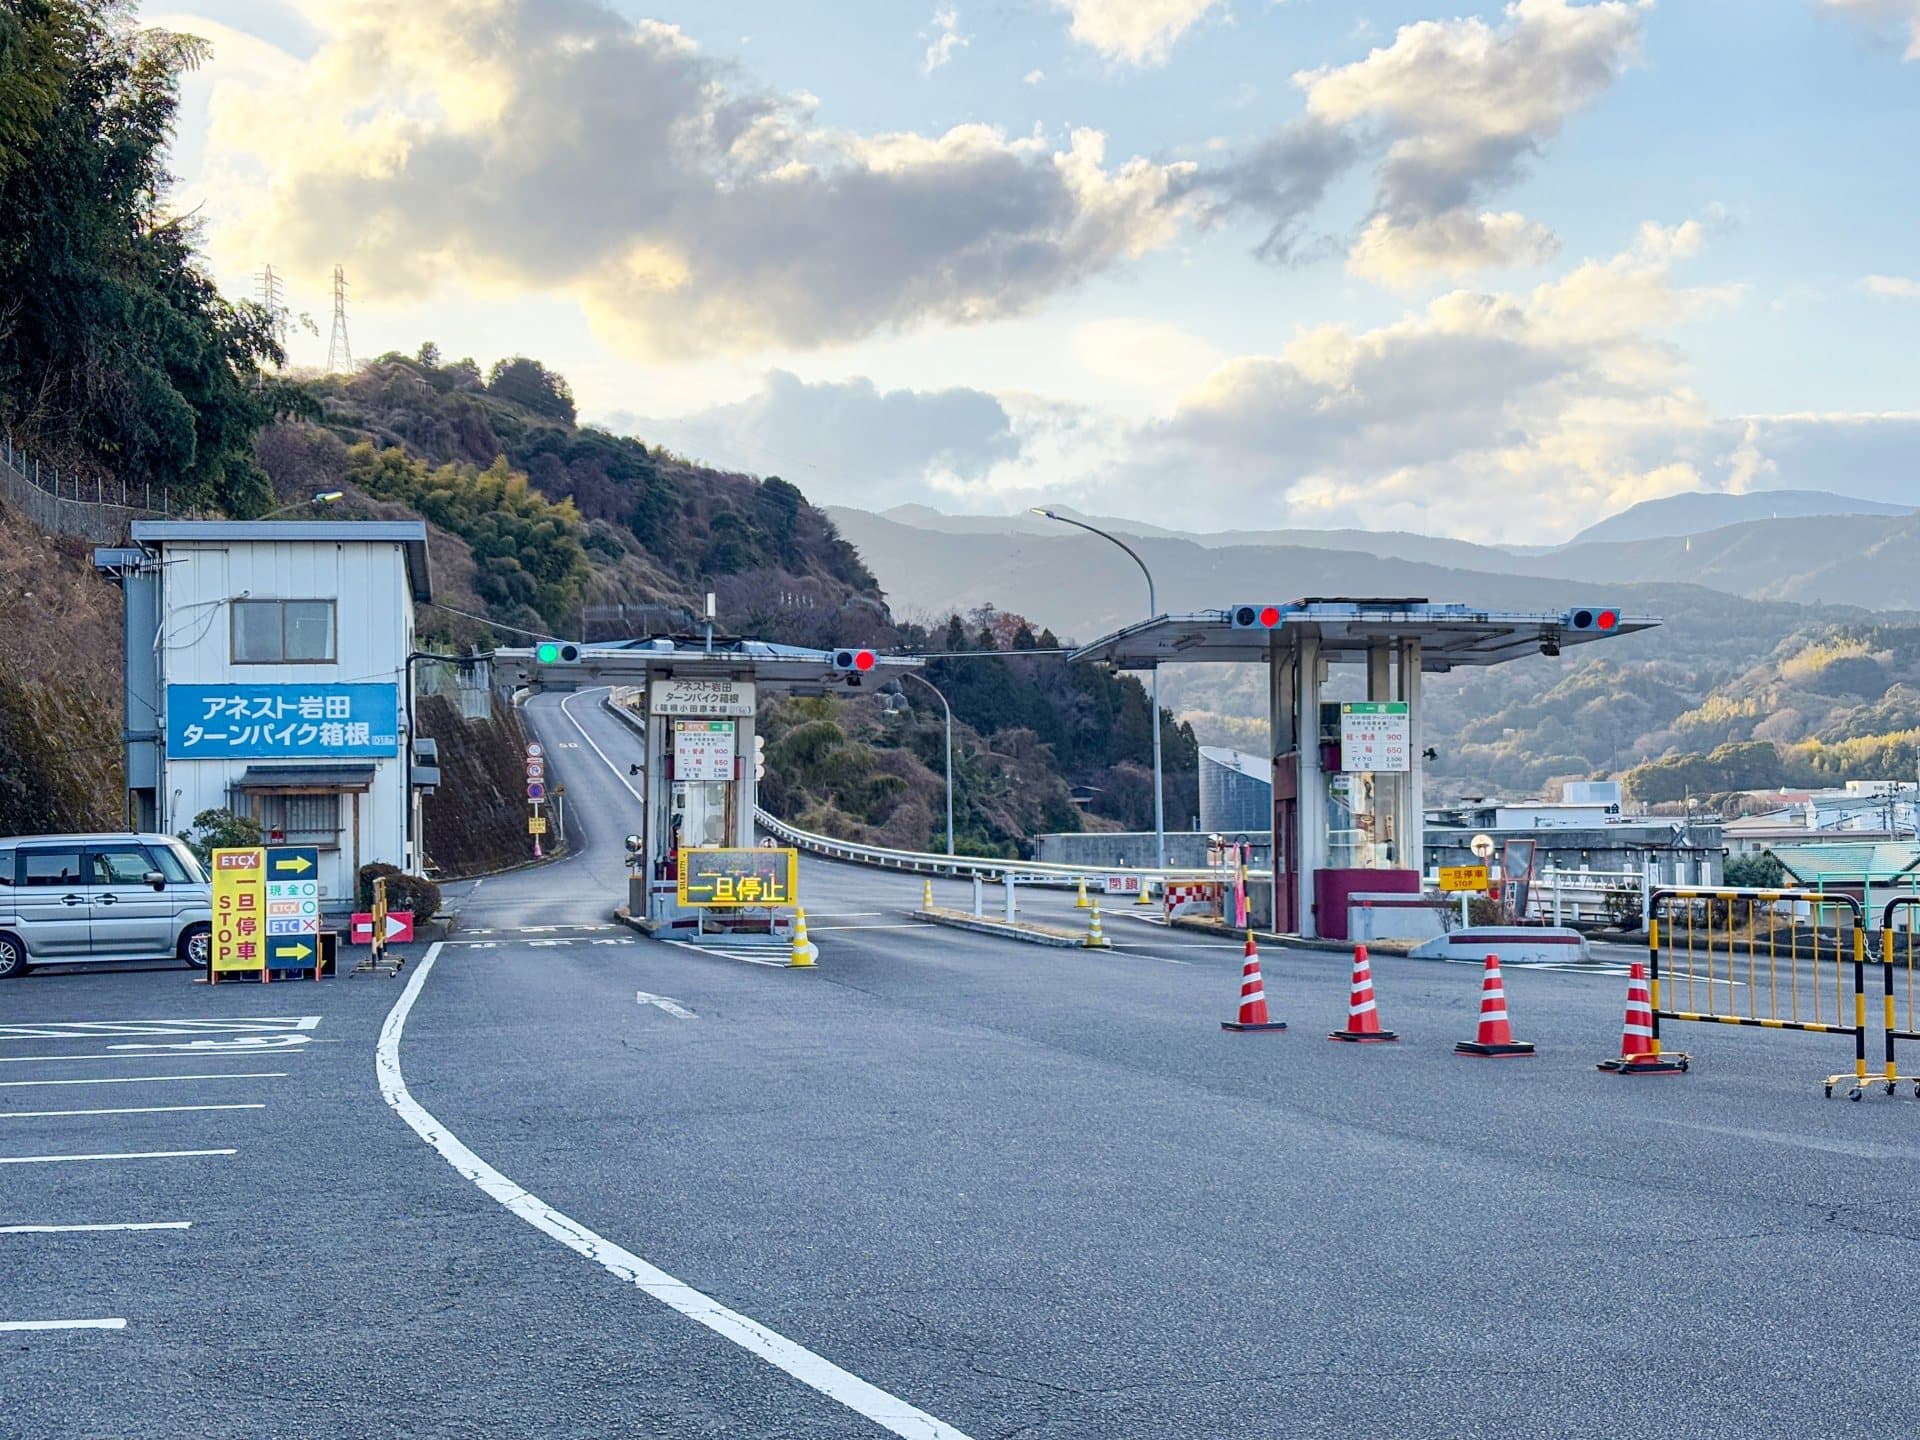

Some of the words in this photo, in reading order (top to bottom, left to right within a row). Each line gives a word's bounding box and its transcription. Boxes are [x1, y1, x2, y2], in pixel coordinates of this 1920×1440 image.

[202, 696, 350, 720] アネスト岩田
[184, 722, 370, 747] ターンパイク箱根
[221, 853, 256, 868] ETCX
[270, 885, 299, 896] 現金
[687, 872, 785, 902] 一旦停止
[1453, 880, 1473, 888] STOP
[271, 902, 298, 914] ETCX
[218, 895, 232, 960] STOP
[236, 879, 257, 960] 一旦停車
[271, 920, 299, 933] ETC
